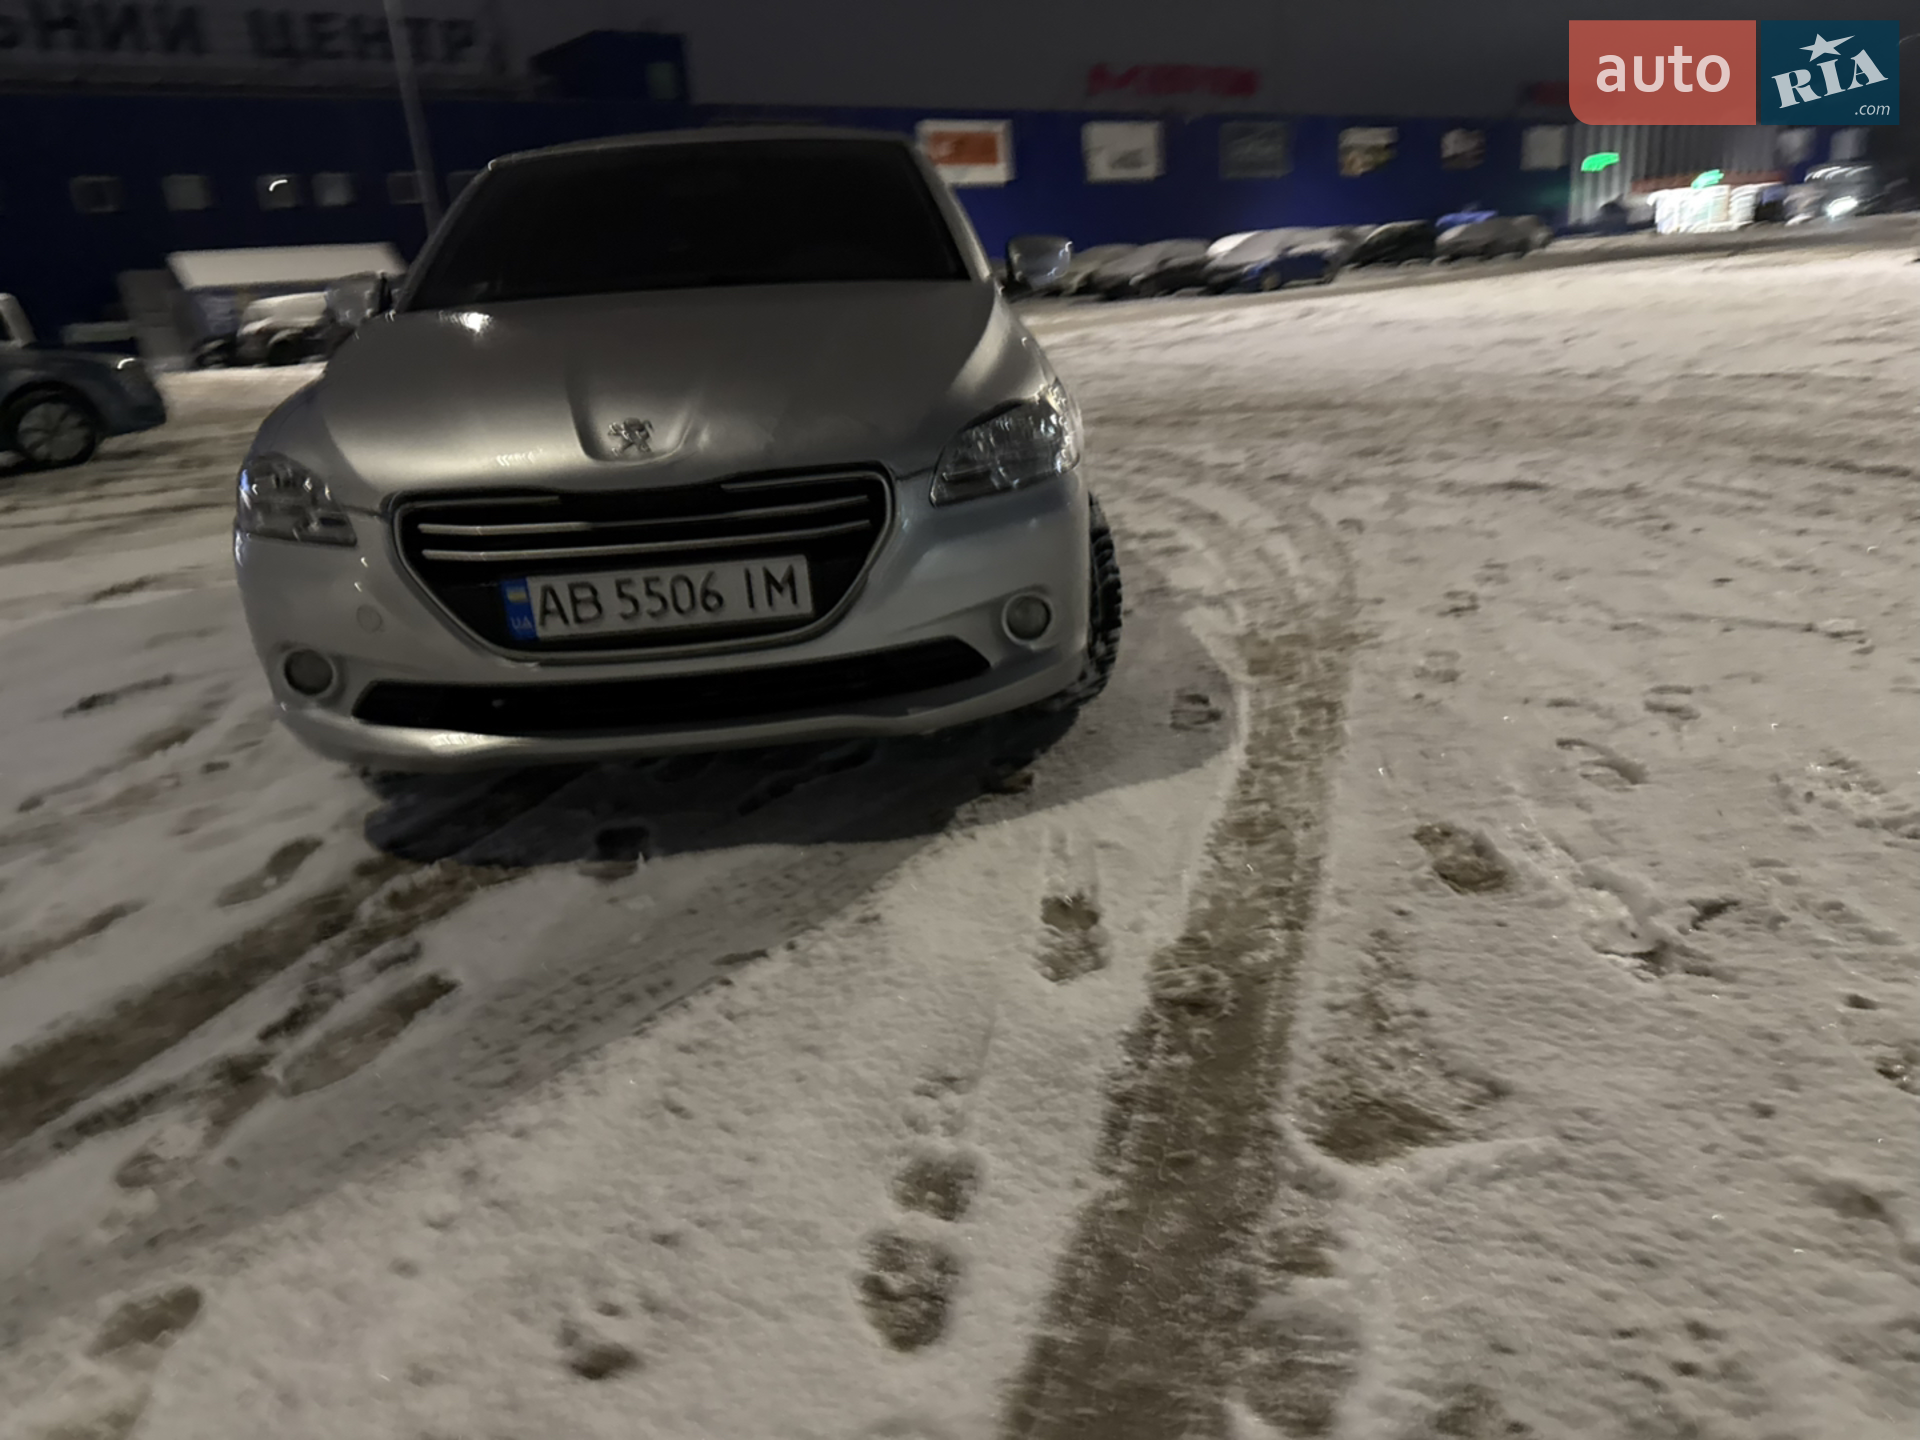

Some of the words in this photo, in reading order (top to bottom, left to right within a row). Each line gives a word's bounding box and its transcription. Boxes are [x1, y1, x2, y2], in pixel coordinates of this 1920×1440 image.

[244, 8, 479, 65] ЦЕНТР
[510, 616, 535, 631] UA
[538, 581, 603, 627] AB
[614, 570, 725, 620] 5506
[743, 564, 799, 610] IM
